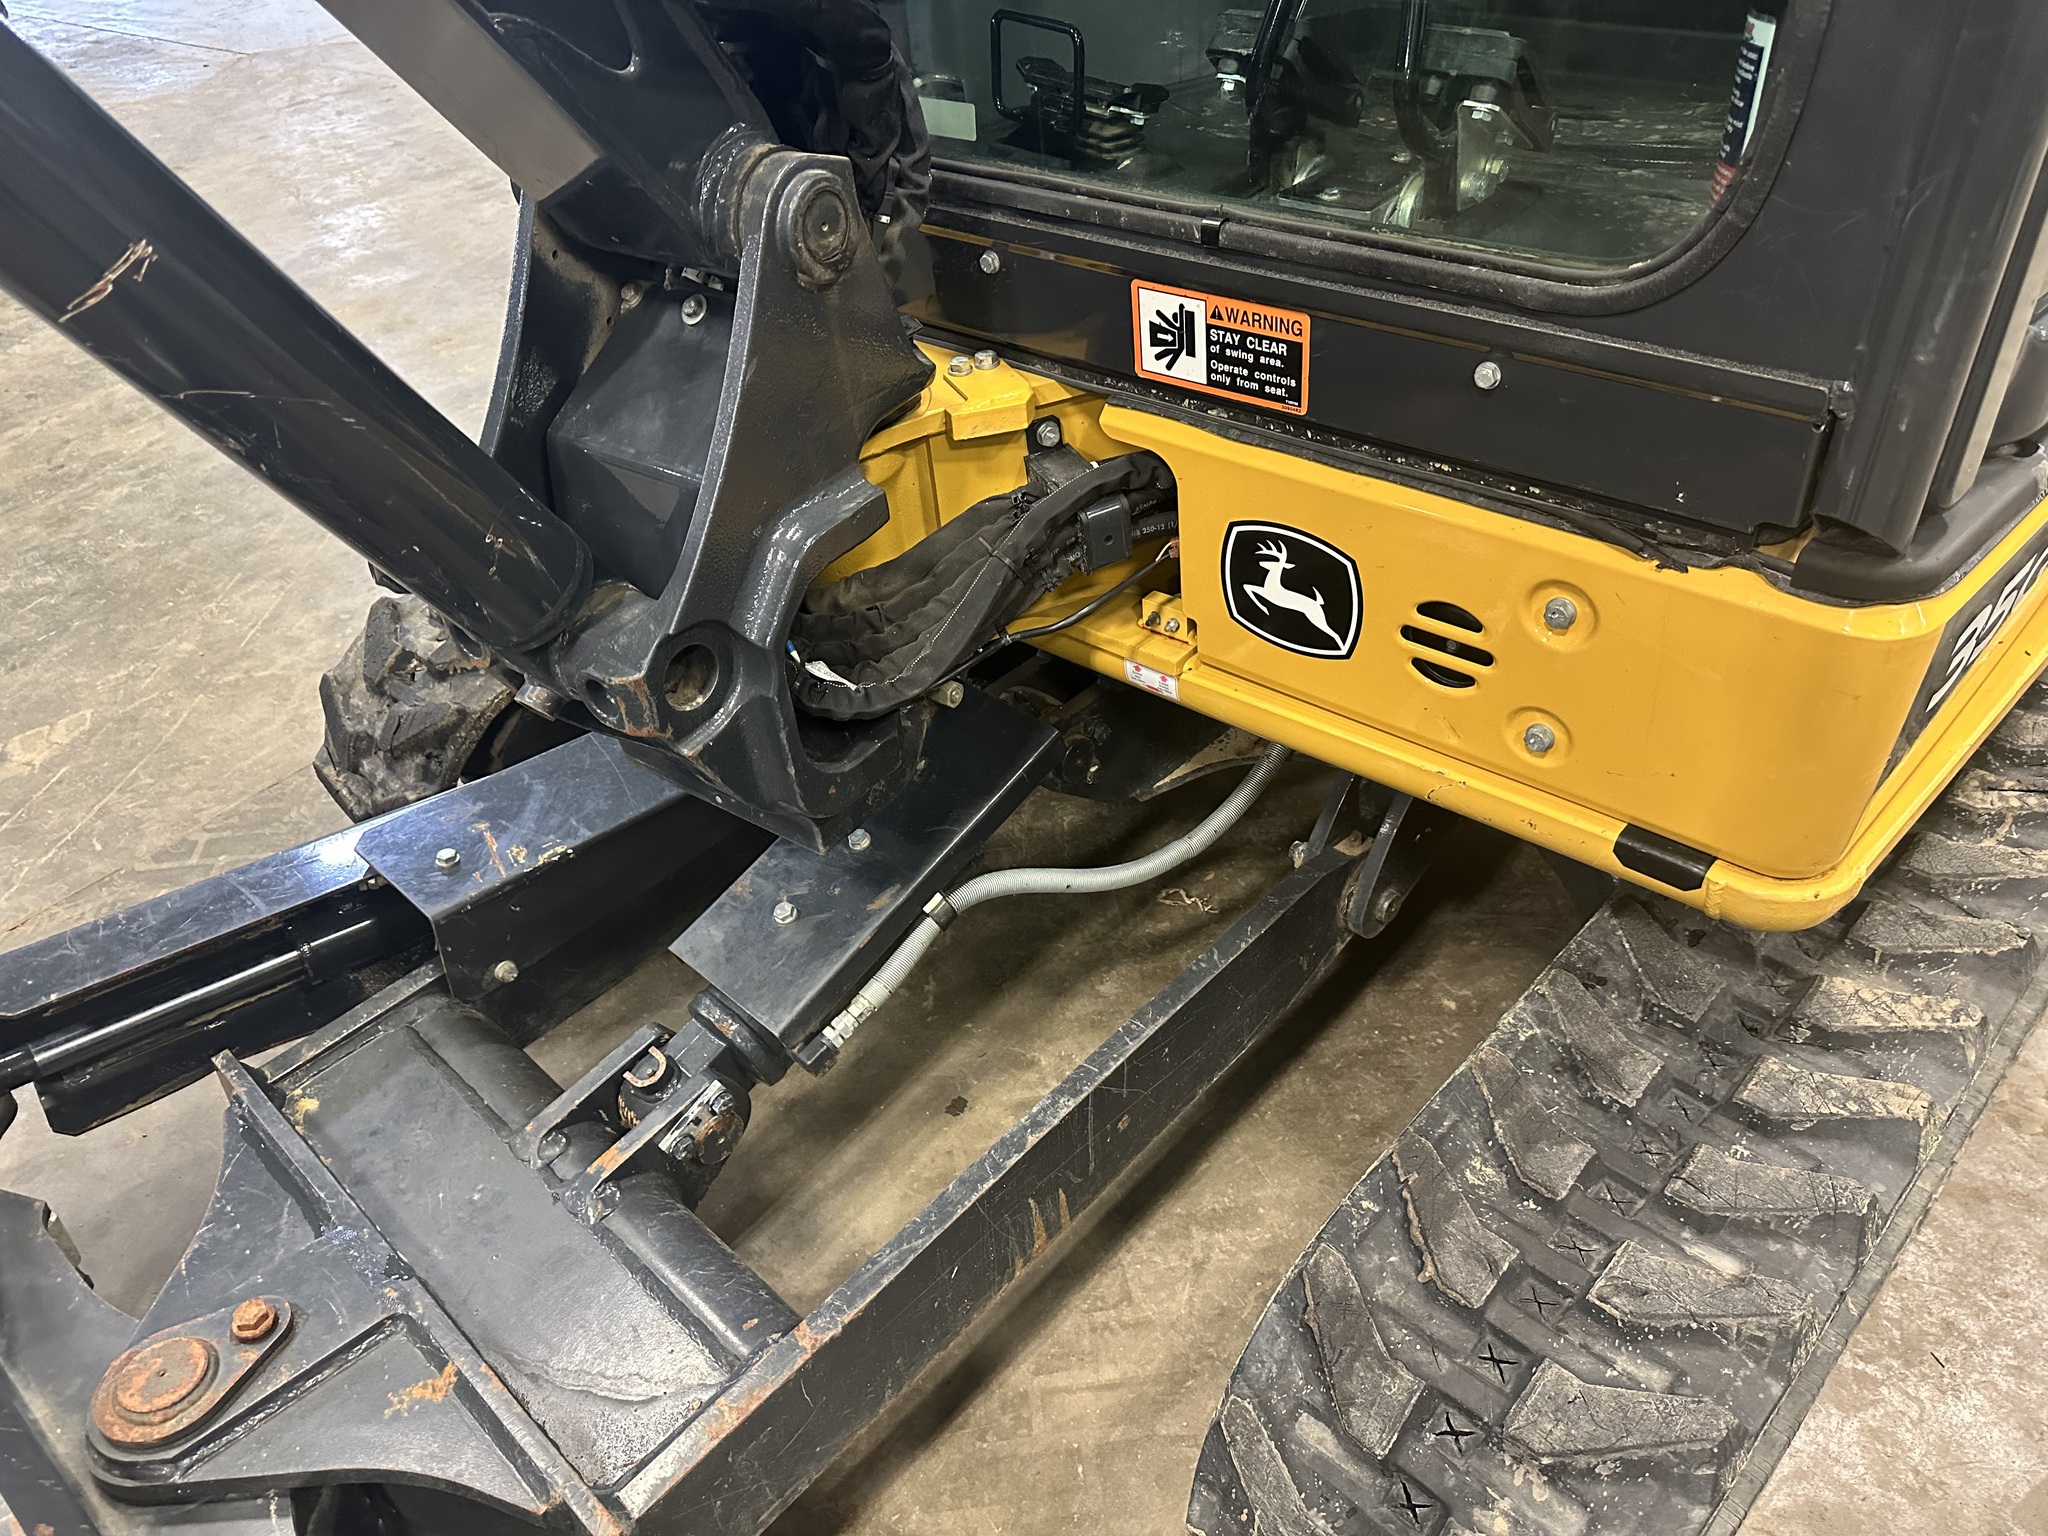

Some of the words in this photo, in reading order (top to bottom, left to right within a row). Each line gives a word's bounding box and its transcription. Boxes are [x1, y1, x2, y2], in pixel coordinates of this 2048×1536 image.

[1225, 306, 1303, 338] WARNING
[1210, 328, 1241, 346] STAY
[1246, 336, 1288, 357] CLEAR
[1210, 344, 1220, 354] of
[1225, 348, 1254, 363] swing
[1259, 355, 1285, 368] area.
[1210, 359, 1249, 377] Operate
[1254, 371, 1297, 387] controls
[1210, 372, 1231, 386] only
[1236, 376, 1259, 391] from
[1264, 385, 1289, 398] seat.
[1142, 523, 1166, 534] 250-12
